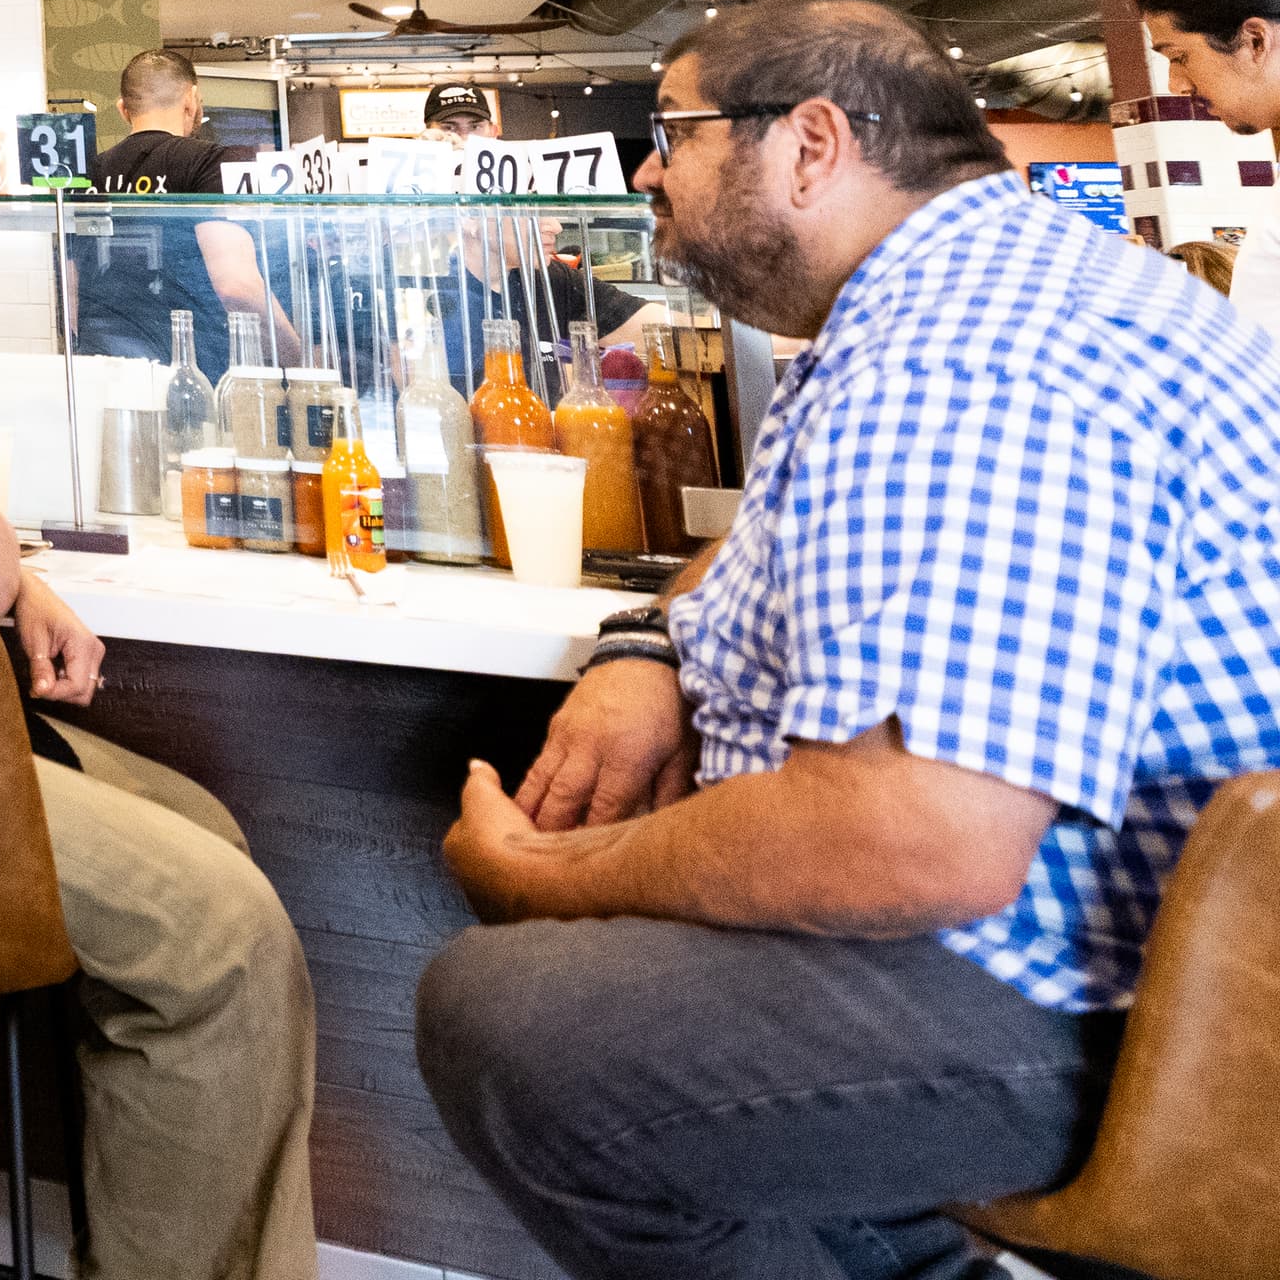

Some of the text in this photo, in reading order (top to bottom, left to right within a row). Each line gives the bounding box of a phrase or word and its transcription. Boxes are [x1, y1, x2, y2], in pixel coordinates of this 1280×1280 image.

[30, 124, 87, 176] 31
[476, 150, 518, 195] 80
[542, 147, 602, 195] 77
